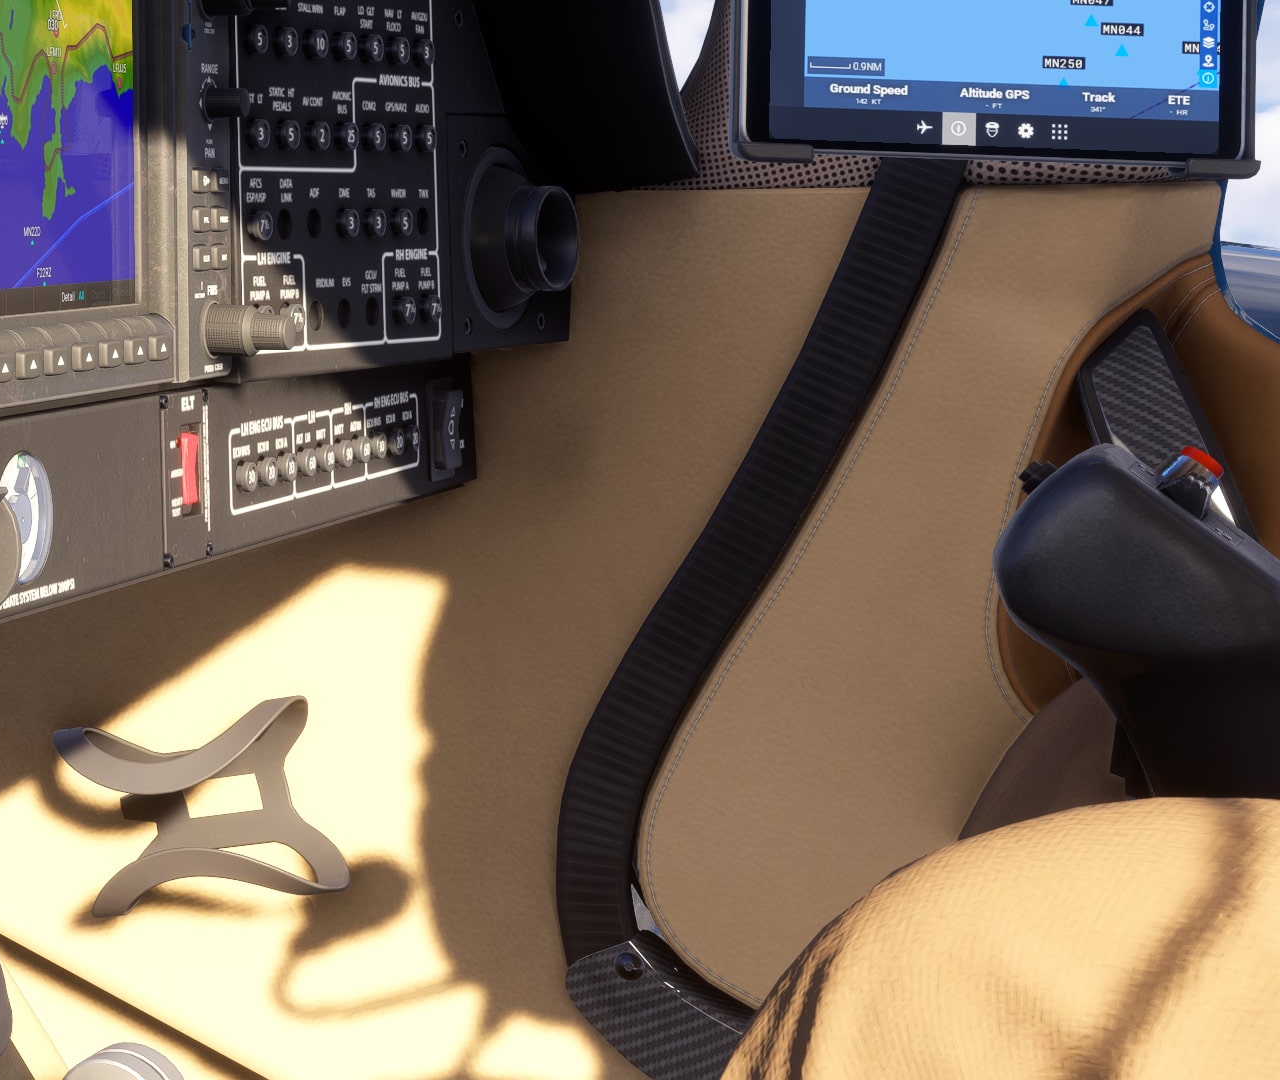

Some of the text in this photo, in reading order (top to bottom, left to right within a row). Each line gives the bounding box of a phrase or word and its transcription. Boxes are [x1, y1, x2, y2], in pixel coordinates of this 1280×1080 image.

[1103, 24, 1141, 36] MN044
[1044, 58, 1083, 69] MN250
[379, 74, 420, 87] AVIONICS BUS
[830, 83, 908, 98] Ground Speed
[960, 88, 1030, 101] Altitude GPS
[1083, 92, 1116, 104] Track
[1168, 95, 1191, 106] ETE
[181, 397, 195, 411] ELT
